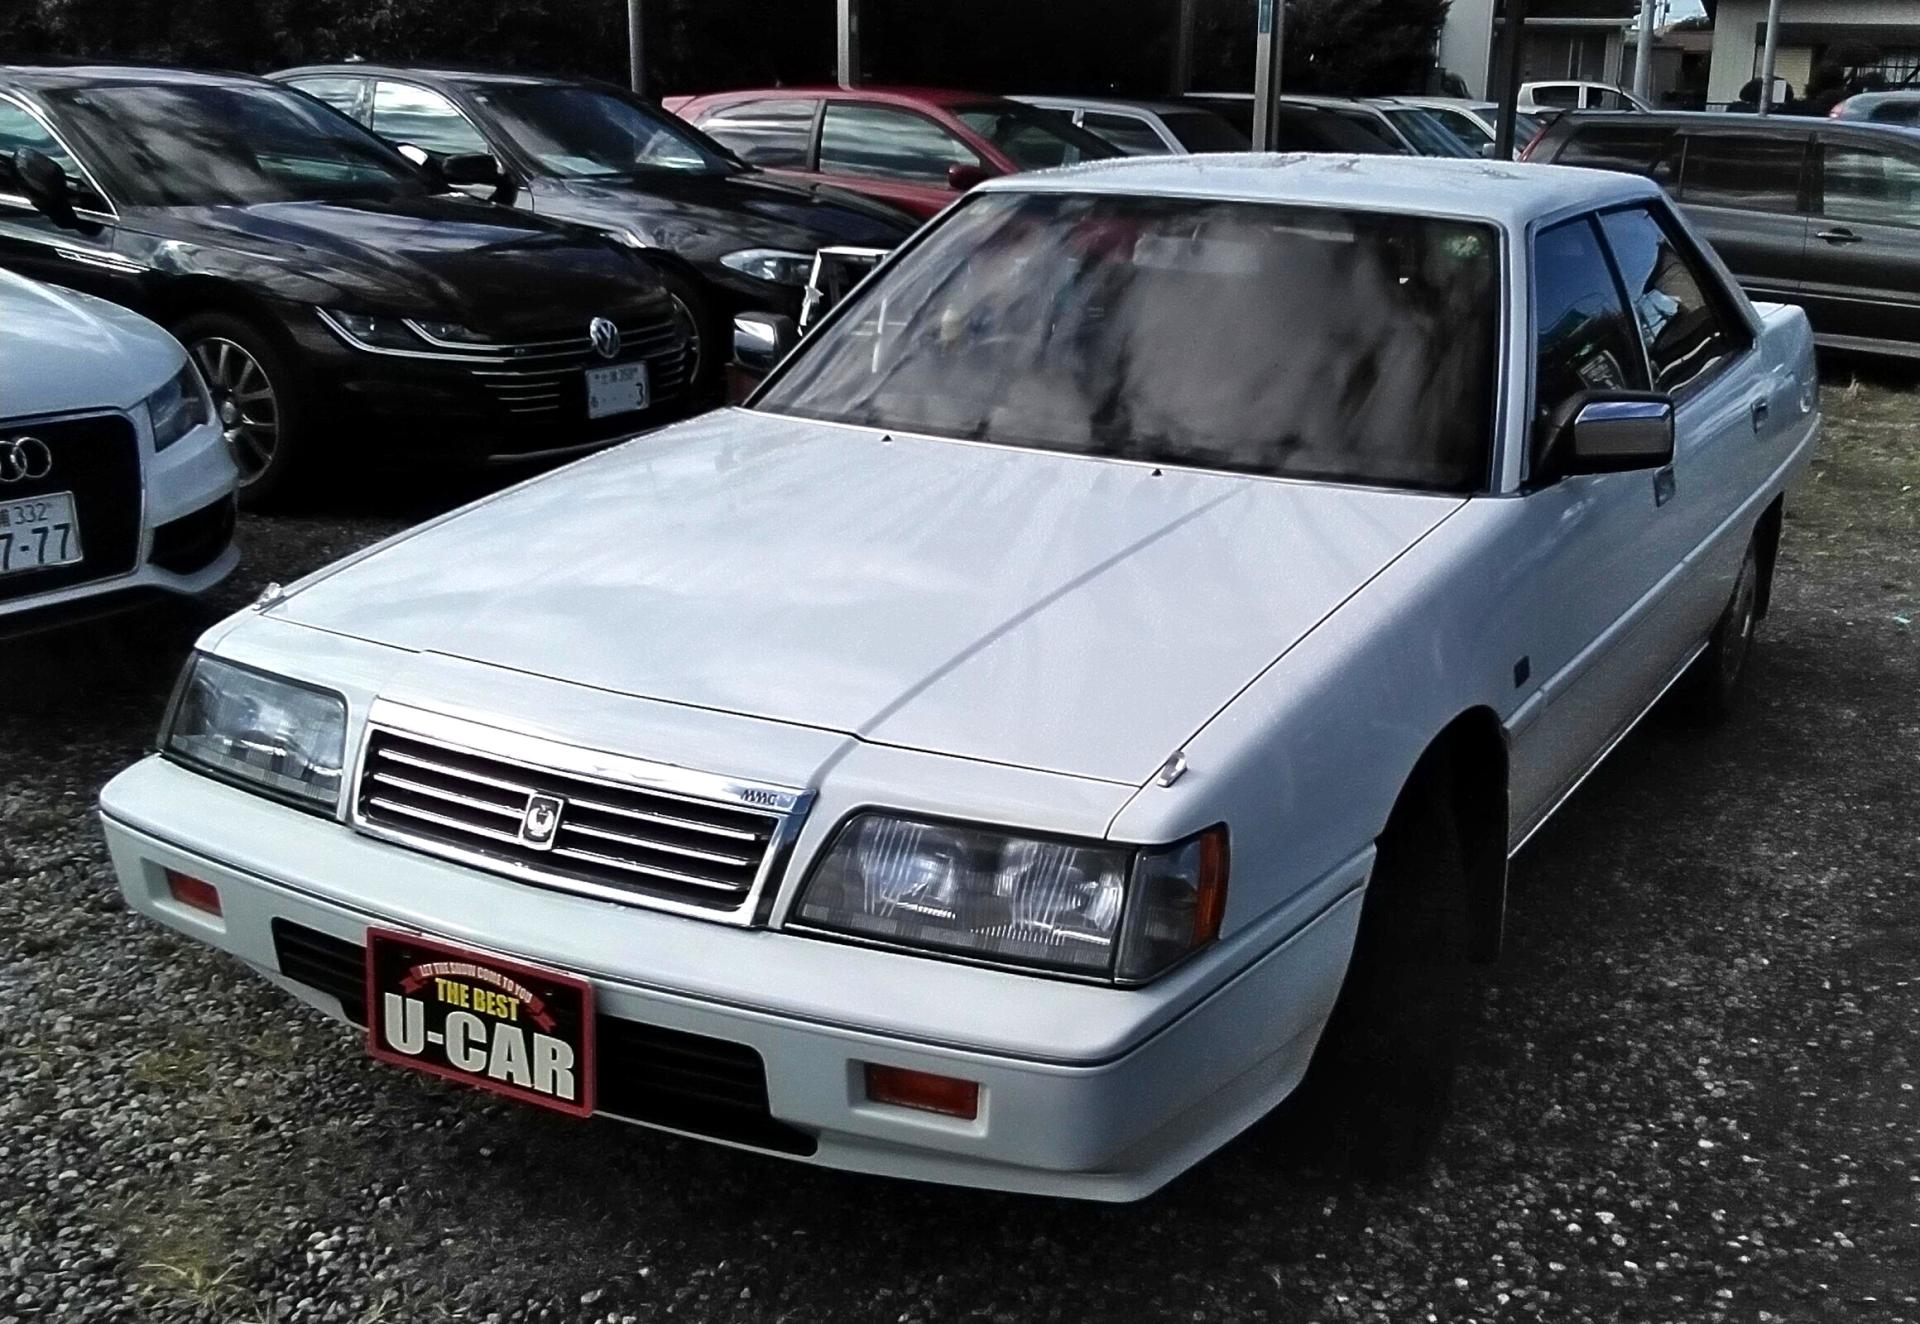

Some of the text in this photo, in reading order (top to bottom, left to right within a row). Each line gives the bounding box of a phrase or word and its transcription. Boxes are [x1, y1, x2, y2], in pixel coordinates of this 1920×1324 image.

[635, 382, 645, 406] 3
[14, 503, 49, 525] 332
[741, 789, 777, 805] MMC
[435, 977, 520, 1021] THE BEST
[502, 976, 515, 992] TO
[514, 983, 533, 1003] YOU
[384, 992, 575, 1100] U-CAR
